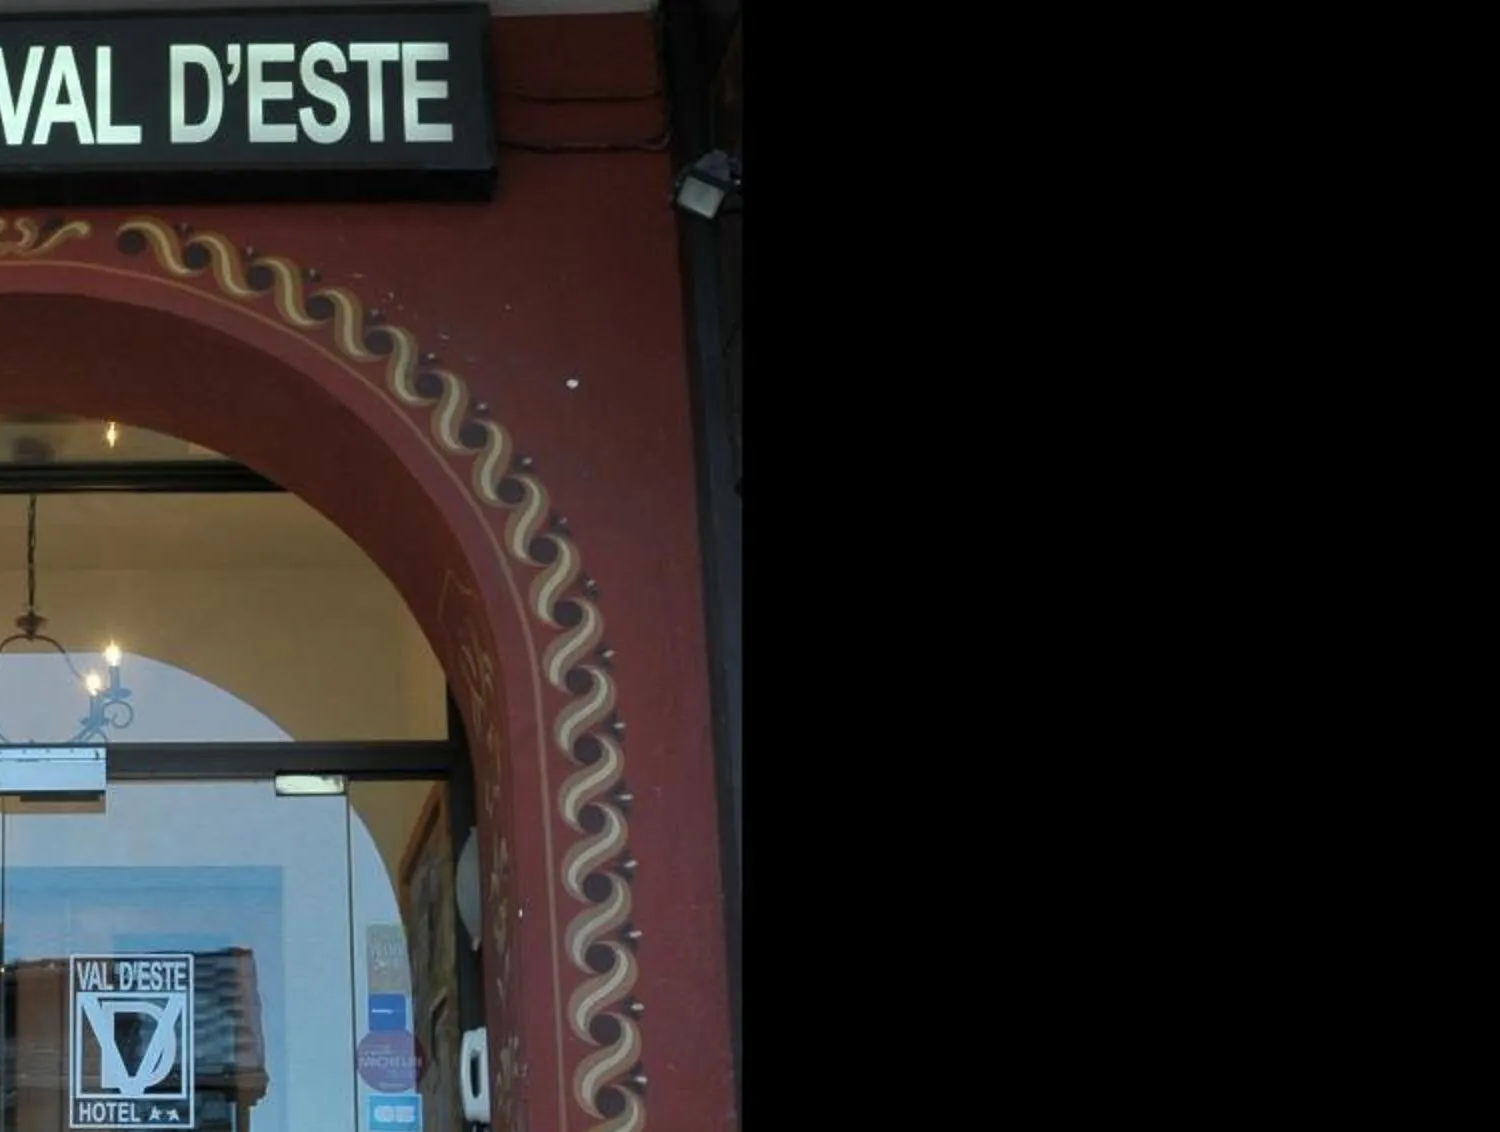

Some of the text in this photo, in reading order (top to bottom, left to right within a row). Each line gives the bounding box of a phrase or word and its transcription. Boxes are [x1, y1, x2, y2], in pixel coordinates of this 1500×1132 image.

[168, 40, 455, 145] D'ESTE
[76, 960, 187, 991] VAL D'ESTE
[79, 1102, 141, 1123] HOTEL
